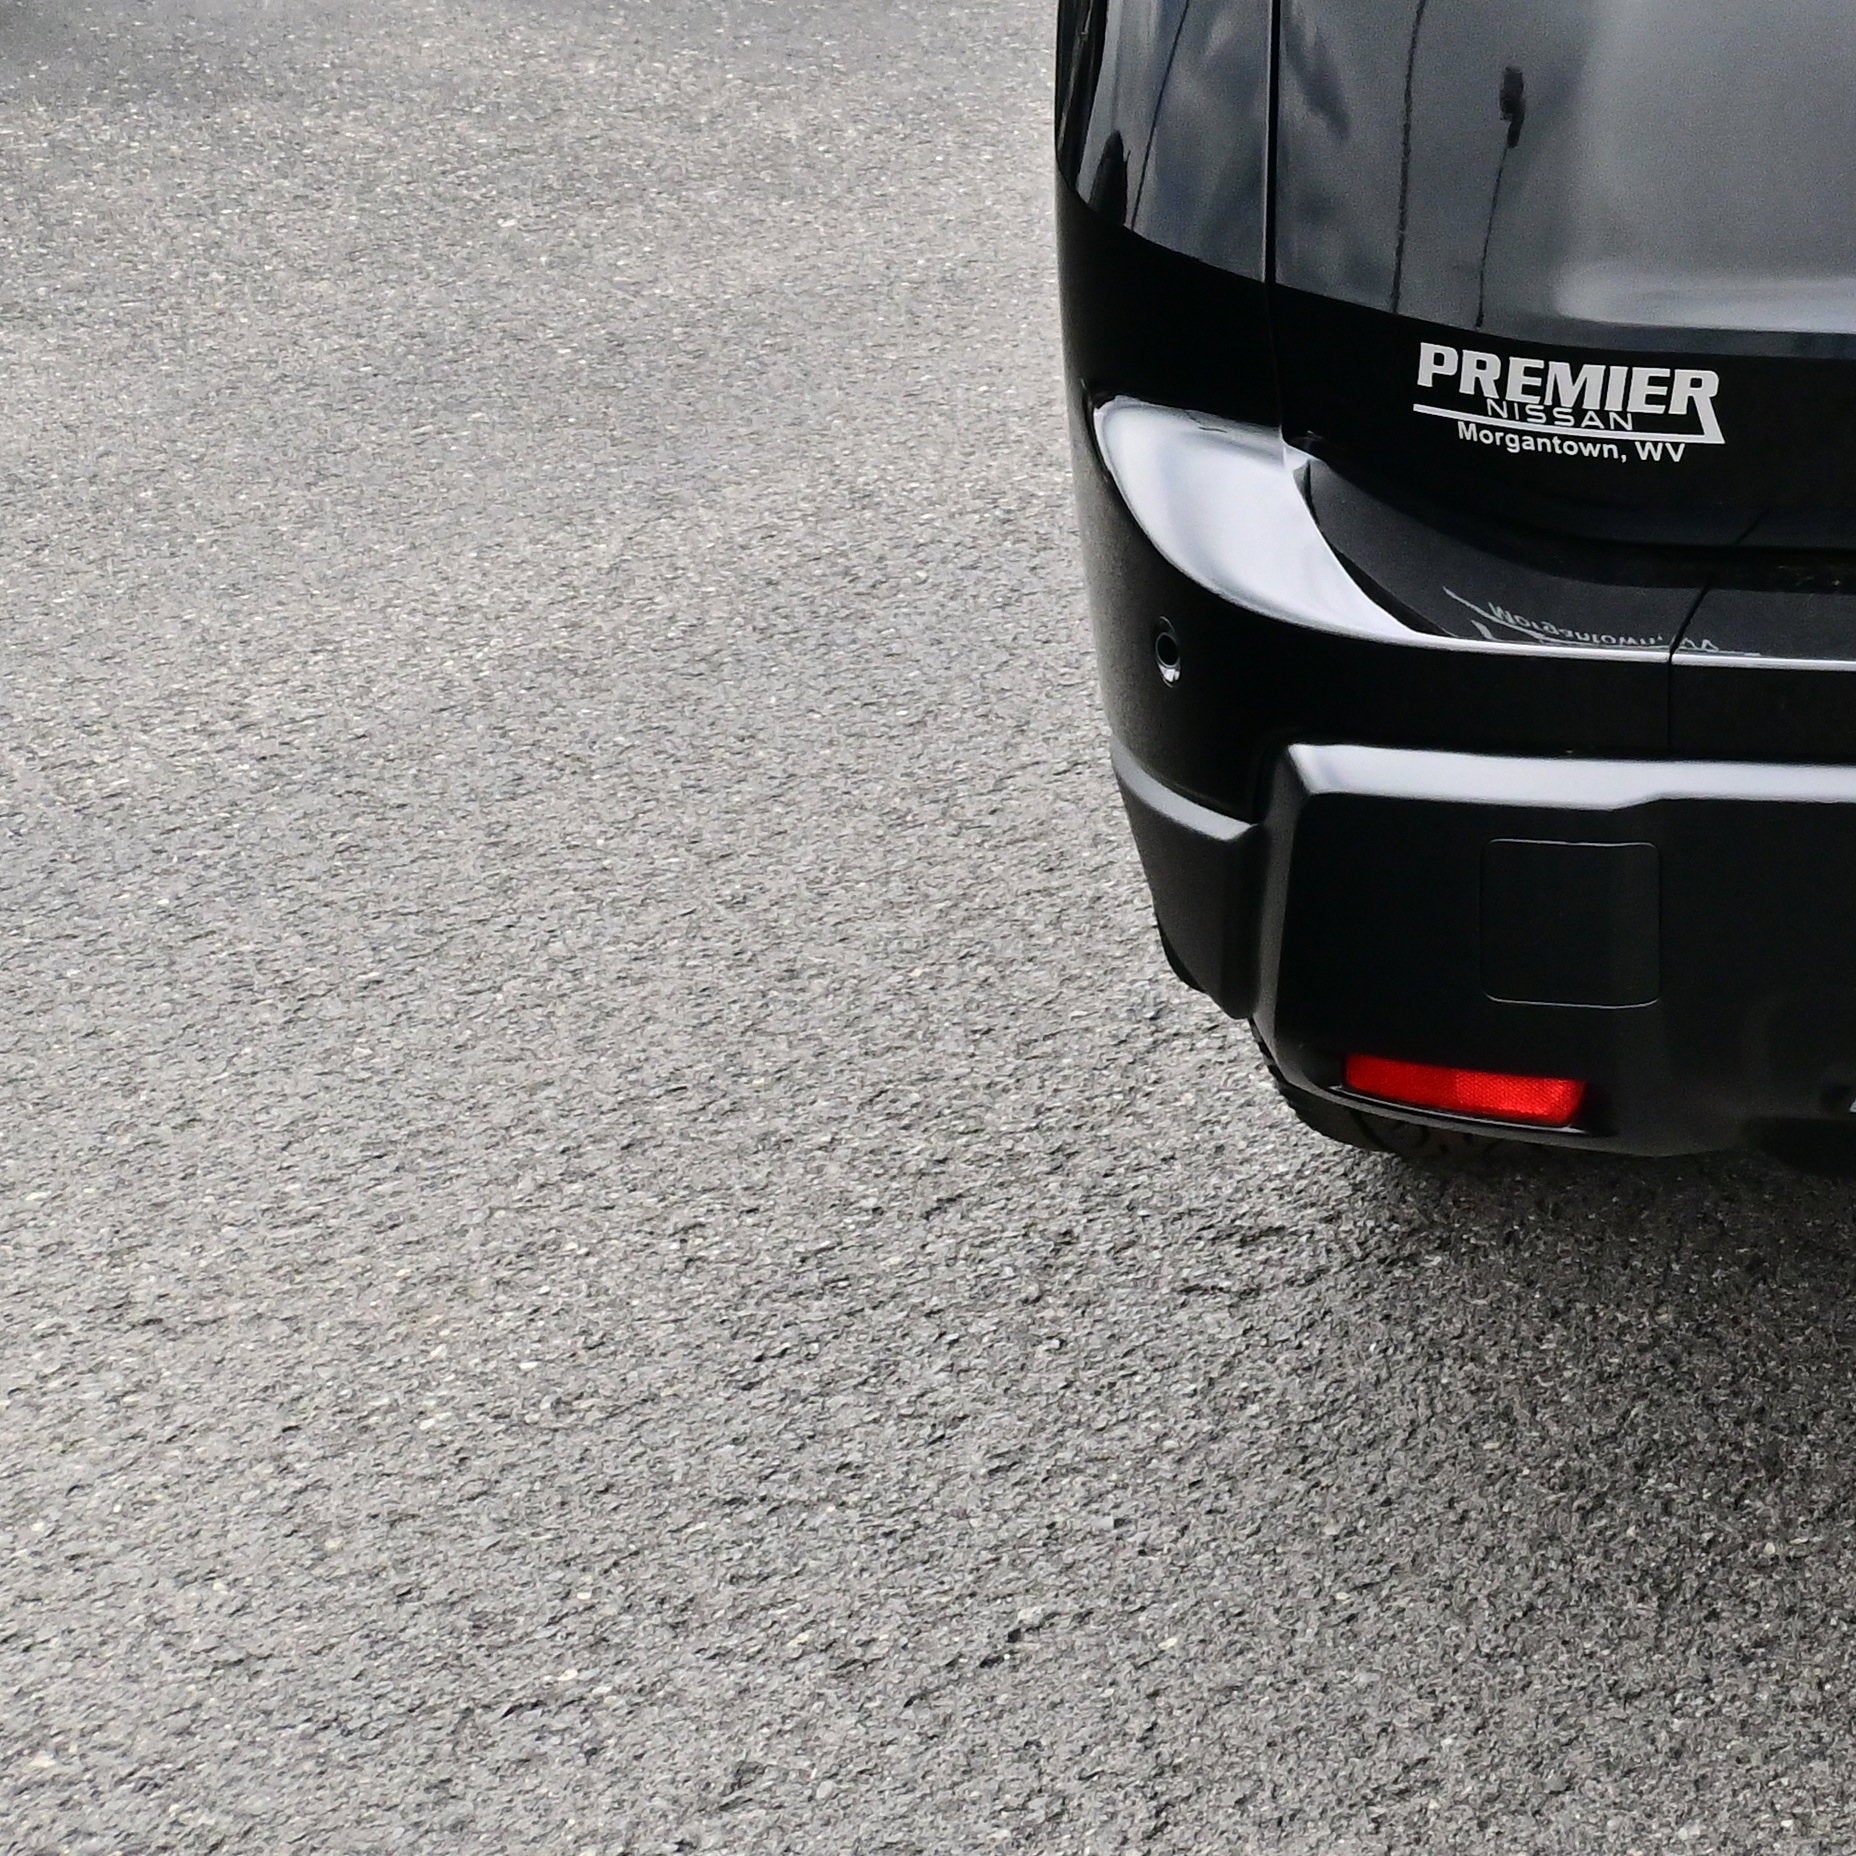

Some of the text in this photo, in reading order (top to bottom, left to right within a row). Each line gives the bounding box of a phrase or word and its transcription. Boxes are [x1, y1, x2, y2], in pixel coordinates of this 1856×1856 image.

[1416, 342, 1725, 444] PREMIER
[1486, 398, 1634, 431] NISSAN
[1458, 420, 1686, 463] Morgantown, WV
